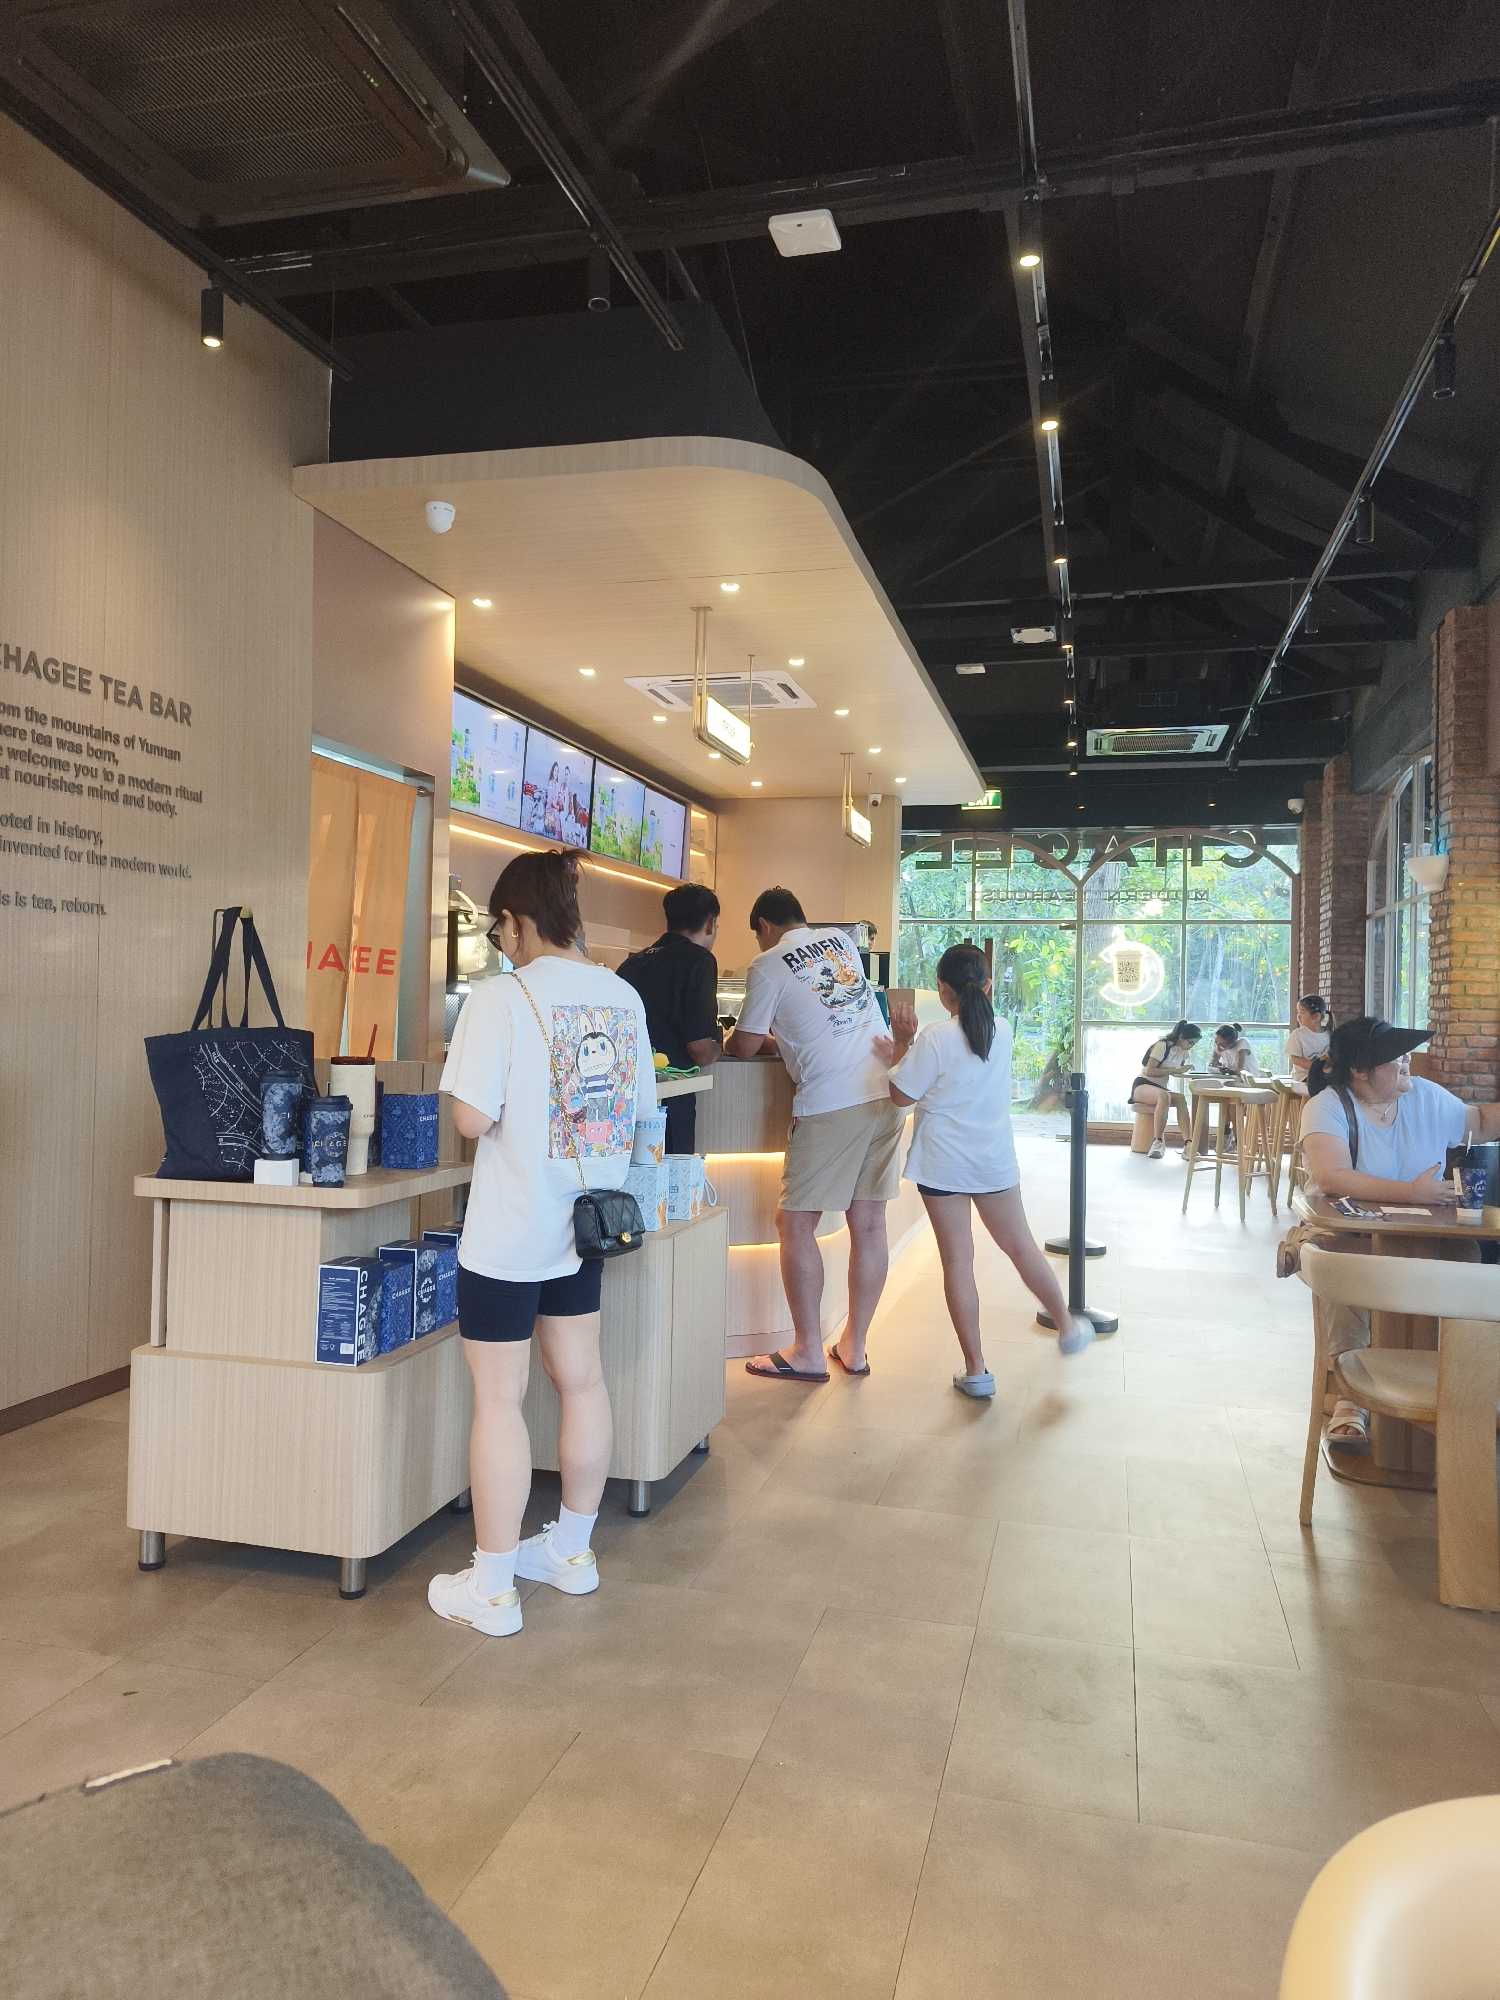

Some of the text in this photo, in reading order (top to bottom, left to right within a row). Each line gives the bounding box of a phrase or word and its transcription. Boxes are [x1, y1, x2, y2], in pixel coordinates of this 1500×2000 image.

[0, 643, 193, 727] HAGEE TEA BAR
[0, 702, 181, 762] om the mountains of Yunnan
[0, 721, 119, 767] ere tea was born,
[7, 746, 71, 772] welcome
[74, 761, 99, 779] you
[102, 767, 114, 783] to
[118, 772, 126, 786] a
[128, 775, 172, 797] modern
[175, 784, 203, 803] ritual
[14, 769, 84, 796] nourishes
[88, 783, 119, 803] mind
[123, 792, 145, 810] and
[148, 795, 178, 818] body.
[0, 812, 104, 846] oted in history,
[64, 845, 84, 863] for
[87, 850, 108, 867] the
[110, 851, 156, 874] modern
[158, 861, 192, 879] world.
[15, 890, 28, 909] is
[32, 893, 57, 914] tea,
[61, 896, 108, 917] reborn.
[782, 935, 845, 970] RAMEN
[358, 1269, 370, 1362] CHAGEE
